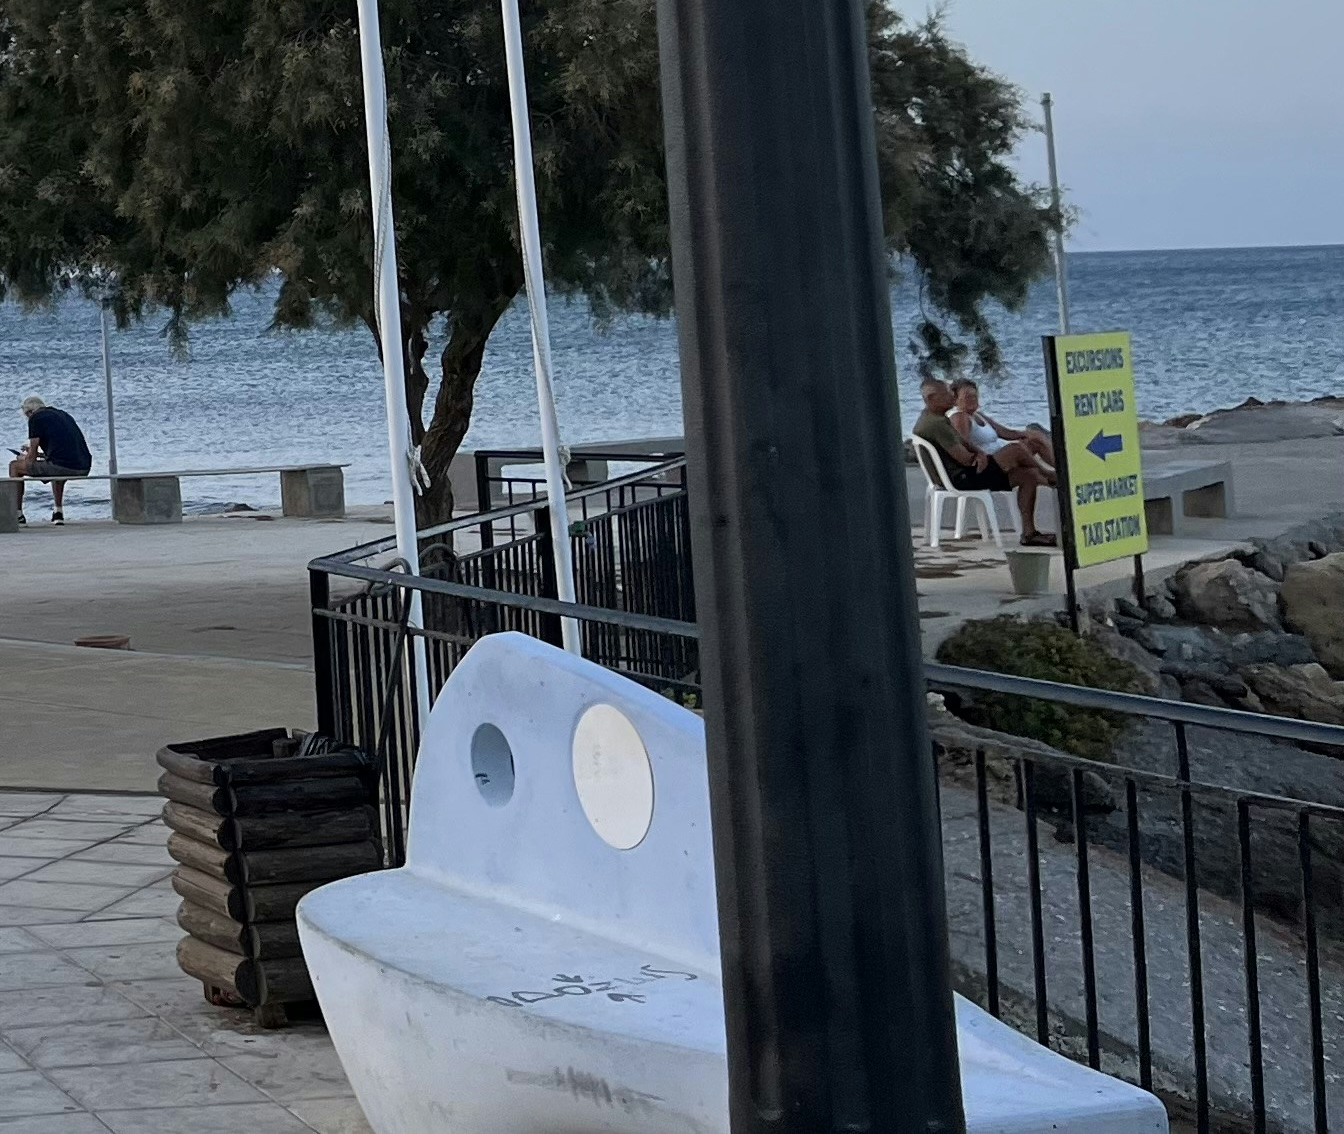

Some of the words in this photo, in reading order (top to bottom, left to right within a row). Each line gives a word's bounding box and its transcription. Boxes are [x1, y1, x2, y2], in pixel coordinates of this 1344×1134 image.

[1065, 347, 1124, 374] EXCURSIONS
[1073, 392, 1098, 417] RENT
[1100, 389, 1124, 413] CARS
[1075, 481, 1105, 505] SUPER
[1105, 474, 1138, 499] MARKET
[1081, 521, 1104, 547] TAXI
[1104, 514, 1141, 542] STATION
